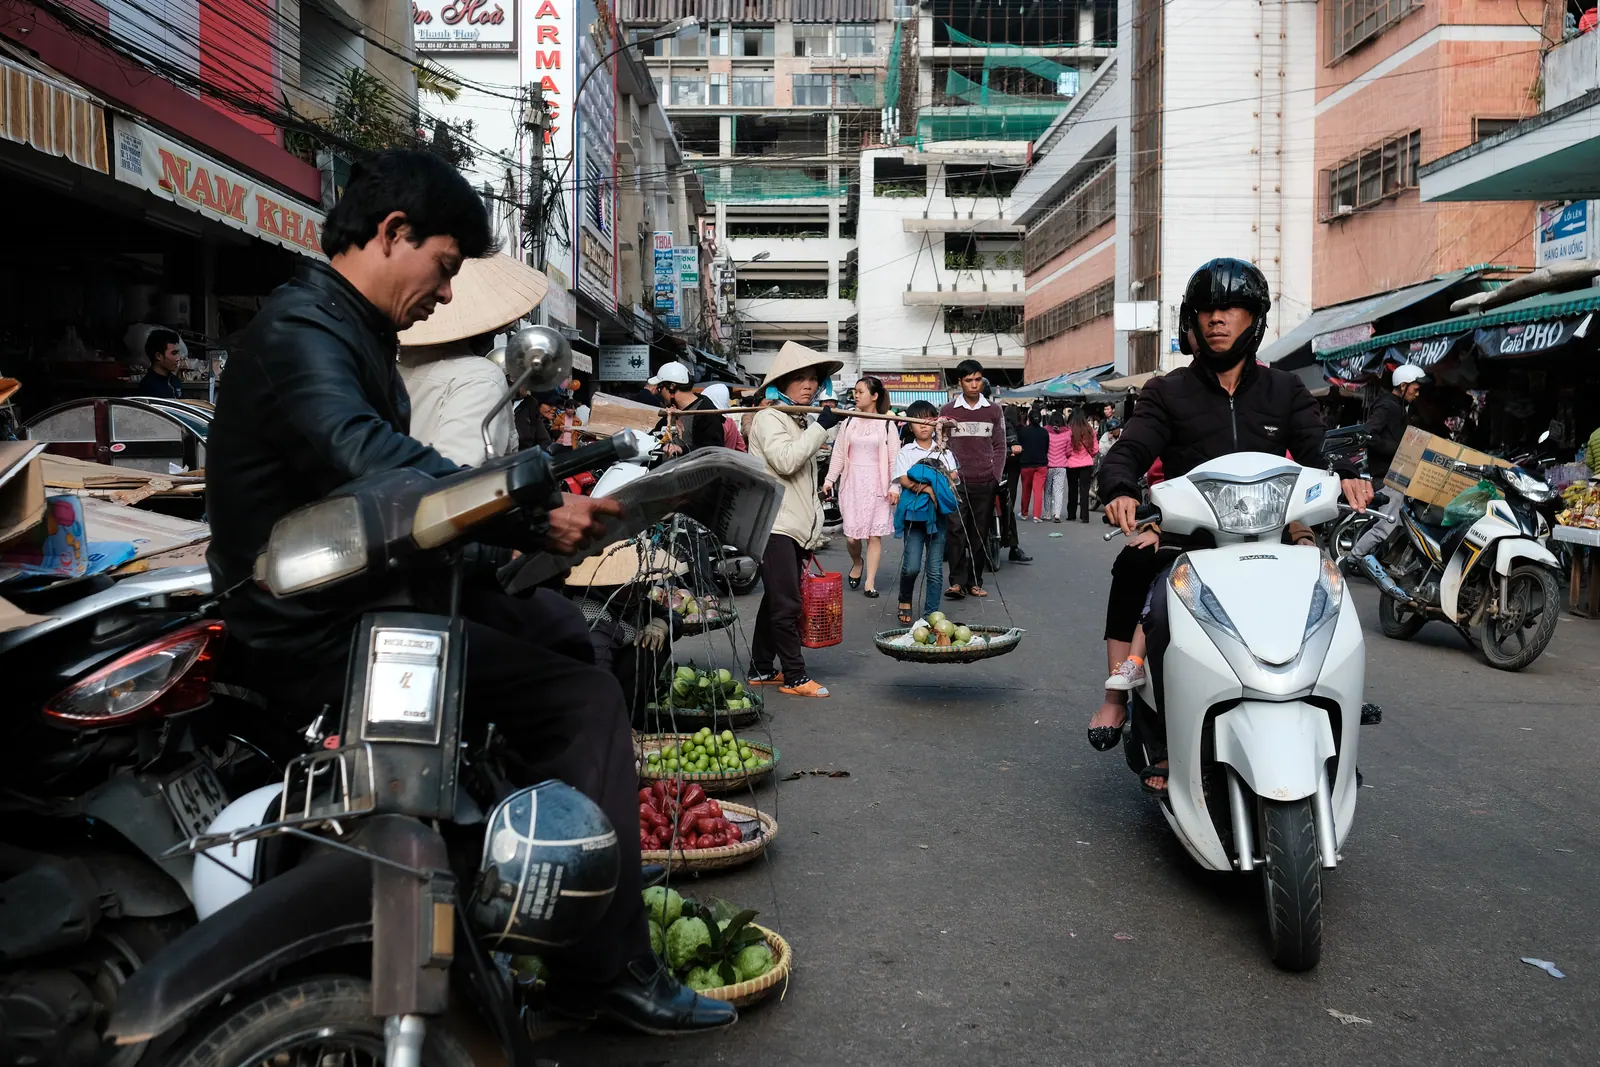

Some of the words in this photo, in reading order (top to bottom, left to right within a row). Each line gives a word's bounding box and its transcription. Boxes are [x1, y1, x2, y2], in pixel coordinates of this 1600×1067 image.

[159, 148, 248, 225] NAM
[256, 194, 325, 258] KHA
[1500, 333, 1523, 353] Café
[1470, 529, 1488, 542] YAMAHA
